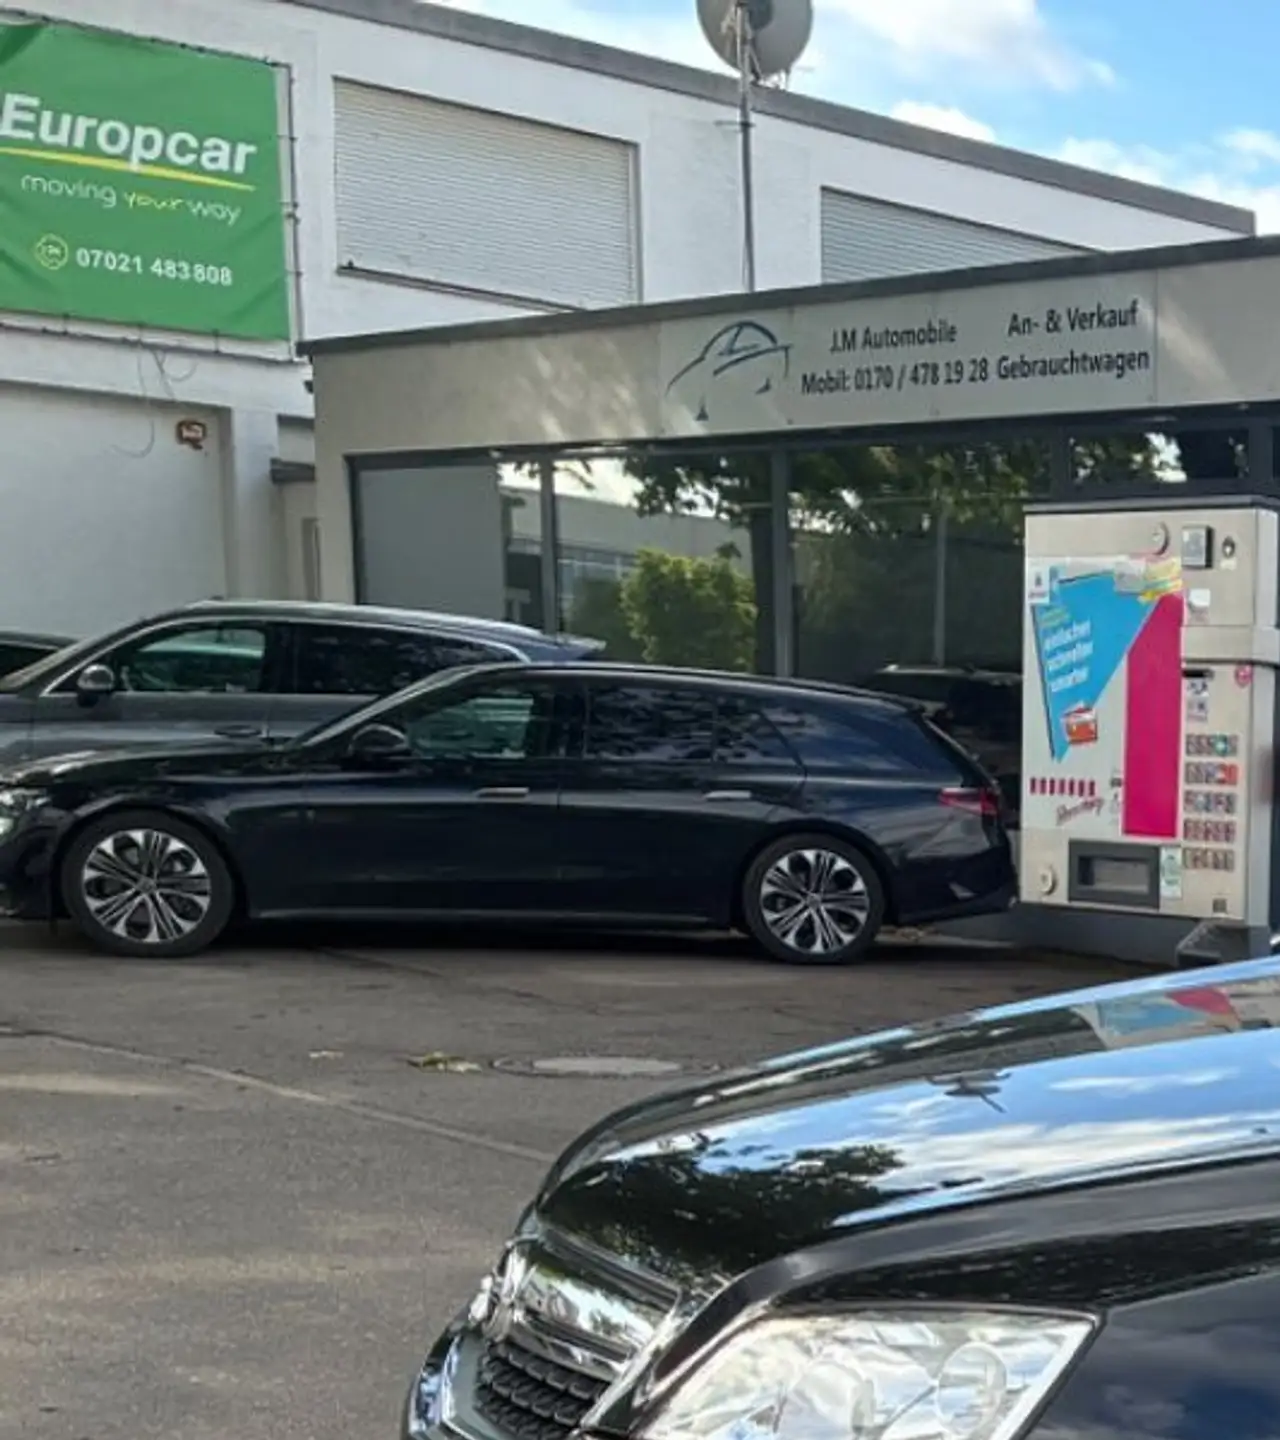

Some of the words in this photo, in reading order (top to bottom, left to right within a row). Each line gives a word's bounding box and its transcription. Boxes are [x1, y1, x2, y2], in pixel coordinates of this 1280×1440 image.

[0, 92, 257, 173] Europcar
[21, 174, 116, 208] moving
[188, 199, 242, 226] way
[76, 248, 143, 274] 07021
[1008, 313, 1039, 336] An-
[1046, 309, 1062, 333] &
[1066, 298, 1138, 331] Verkauf
[862, 320, 957, 349] Automobile
[854, 365, 894, 391] 0170
[909, 362, 939, 385] 478
[944, 360, 963, 384] 19
[969, 357, 988, 383] 28
[998, 349, 1149, 379] Gebrauchtwagen
